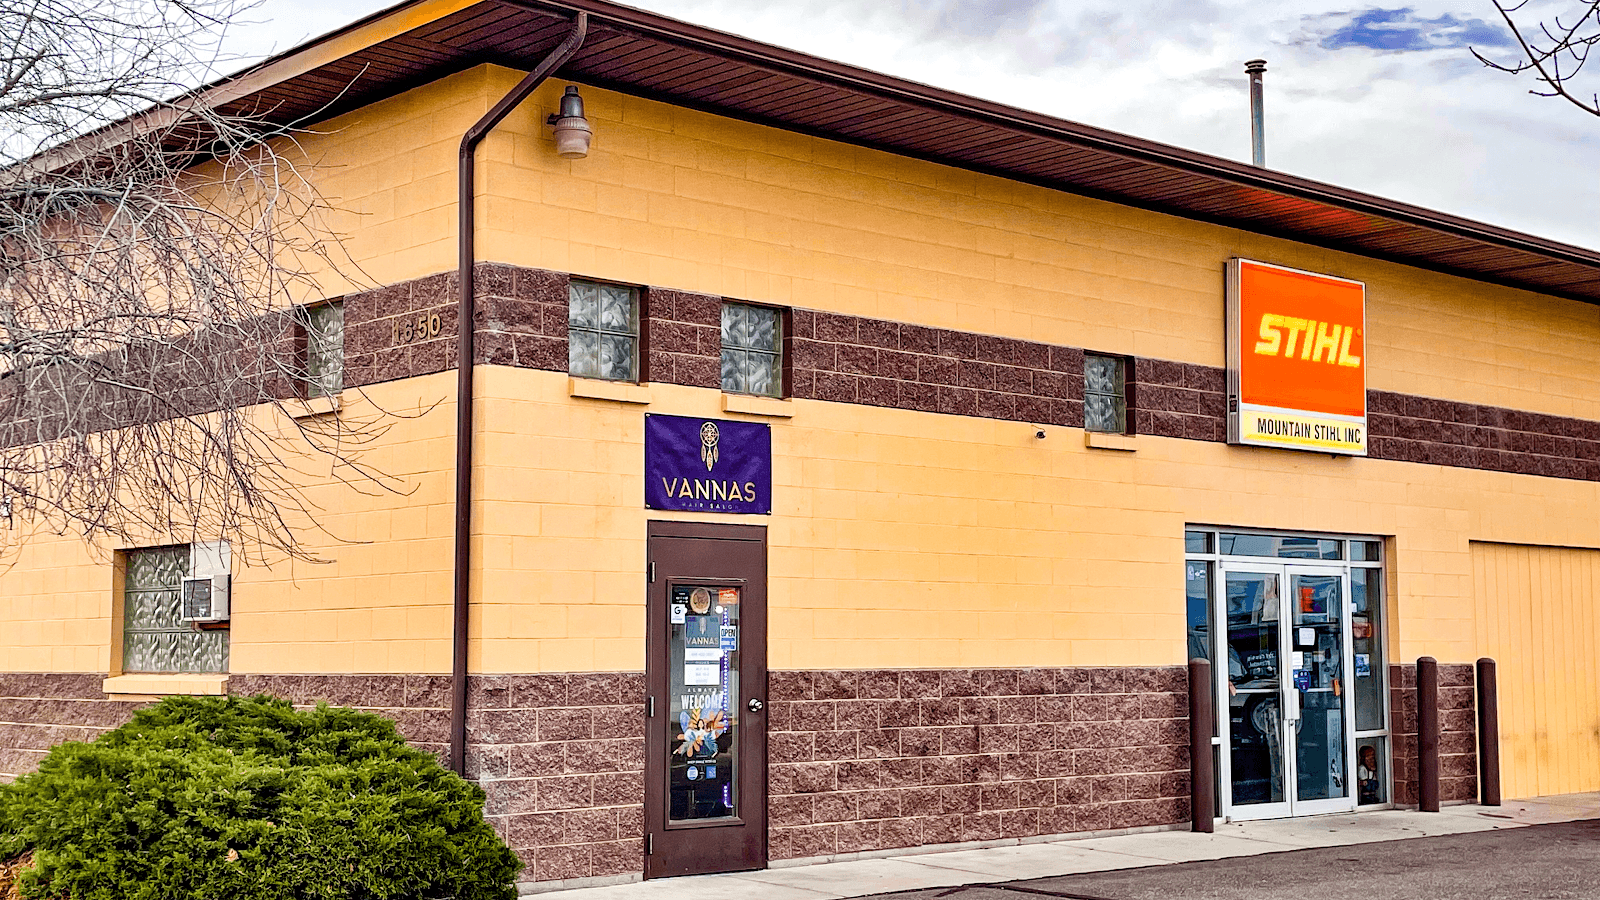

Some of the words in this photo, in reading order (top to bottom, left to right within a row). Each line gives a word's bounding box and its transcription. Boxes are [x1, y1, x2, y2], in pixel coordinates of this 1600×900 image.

[393, 314, 441, 342] 1650
[1254, 313, 1361, 368] STIHL
[1257, 417, 1311, 439] MOUNTAIN
[1314, 424, 1342, 442] STIHL
[1344, 427, 1361, 443] INC
[662, 477, 756, 502] VANNAS
[686, 636, 719, 645] VANNAS
[721, 628, 735, 637] OPEN
